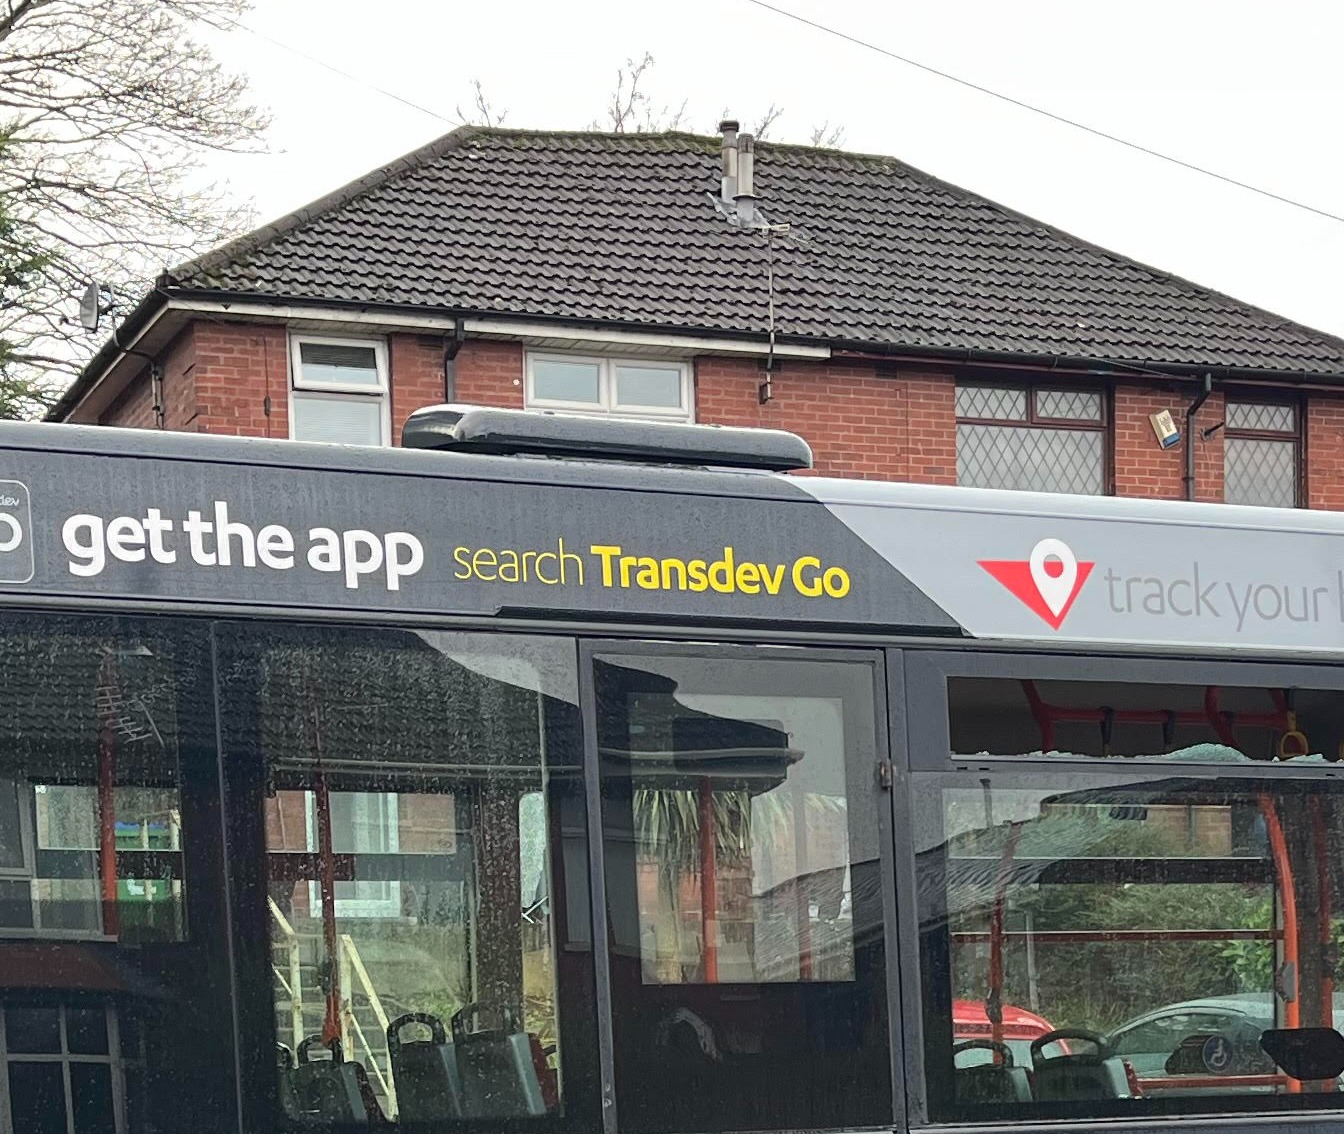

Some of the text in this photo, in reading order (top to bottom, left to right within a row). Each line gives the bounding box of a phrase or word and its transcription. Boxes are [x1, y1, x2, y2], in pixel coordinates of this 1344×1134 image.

[62, 501, 424, 591] get the app
[454, 538, 851, 598] search Transdev Go
[1104, 561, 1220, 618] track
[1225, 582, 1329, 632] your
